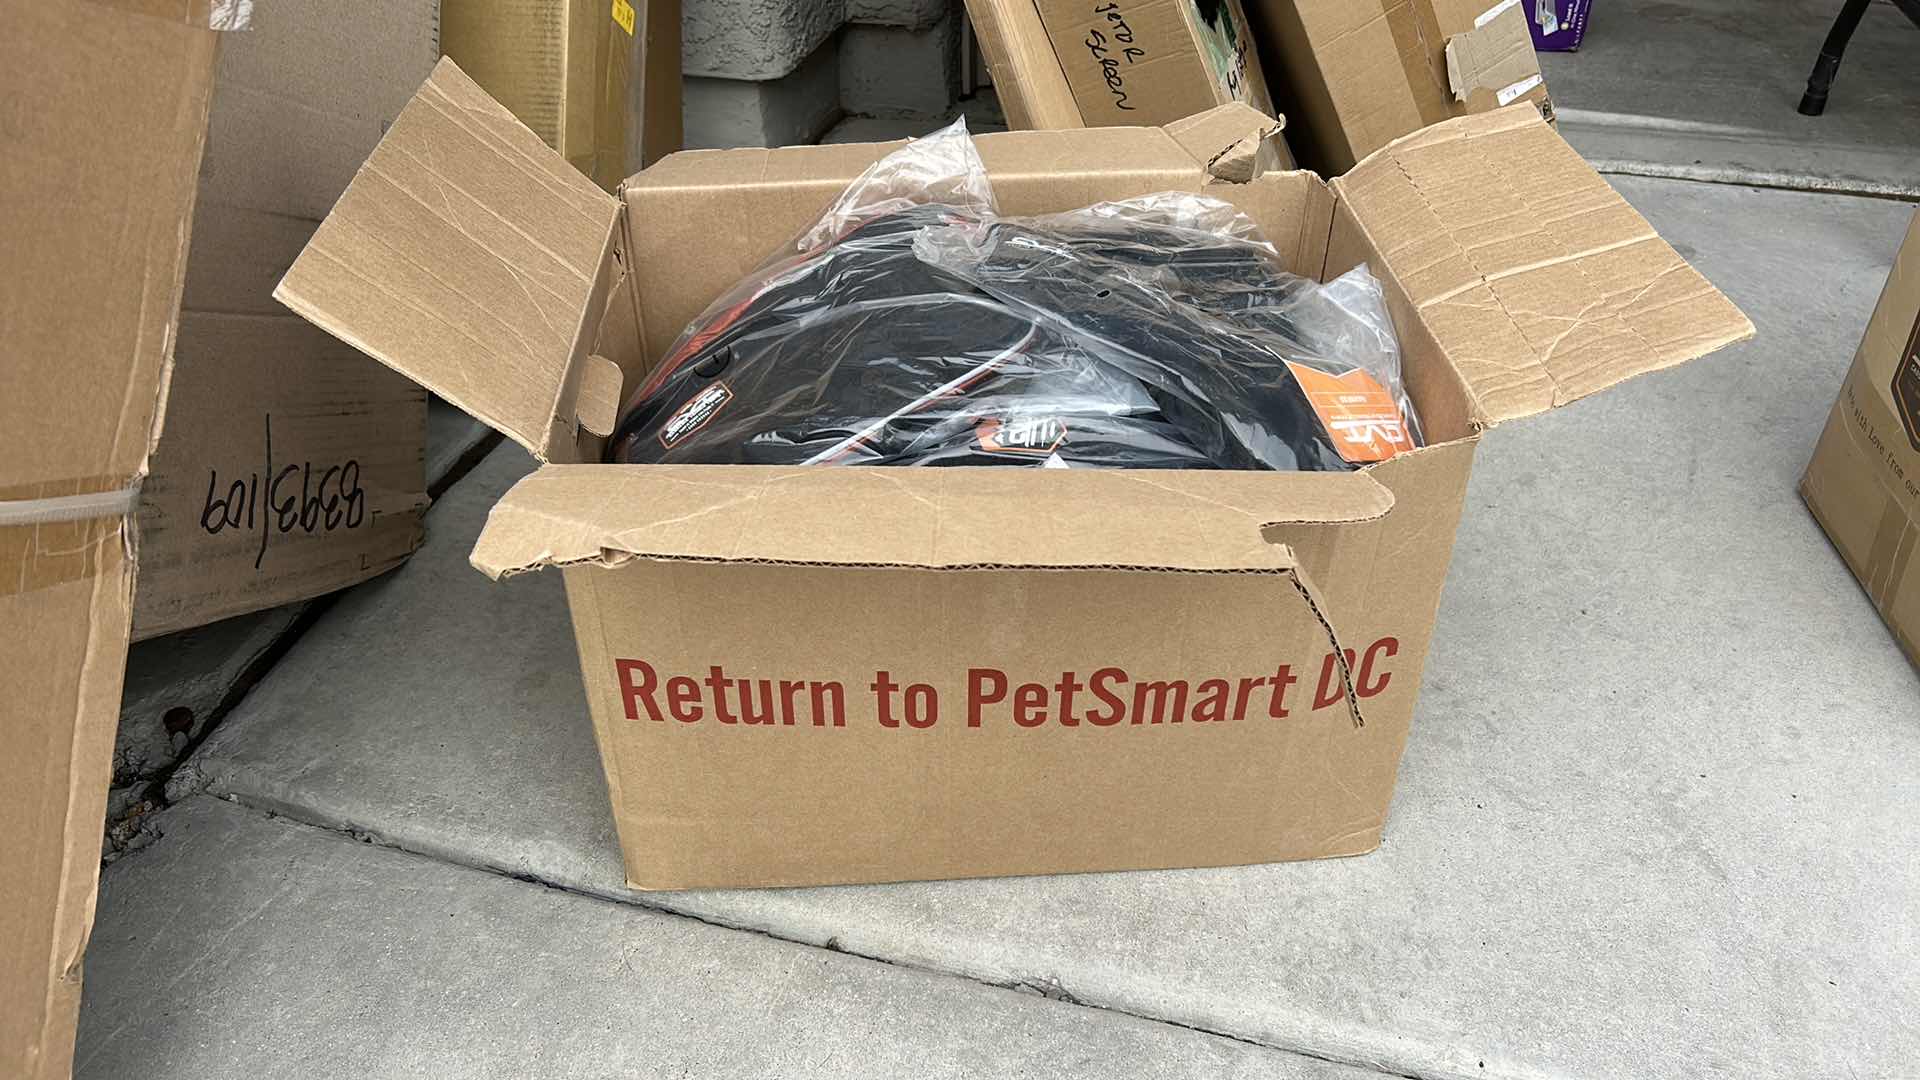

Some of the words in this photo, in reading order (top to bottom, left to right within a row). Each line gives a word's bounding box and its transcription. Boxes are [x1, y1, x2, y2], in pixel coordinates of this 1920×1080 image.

[616, 659, 845, 728] Return
[874, 671, 938, 729] to
[968, 665, 1297, 729] PetSmart
[1312, 637, 1398, 711] DC
